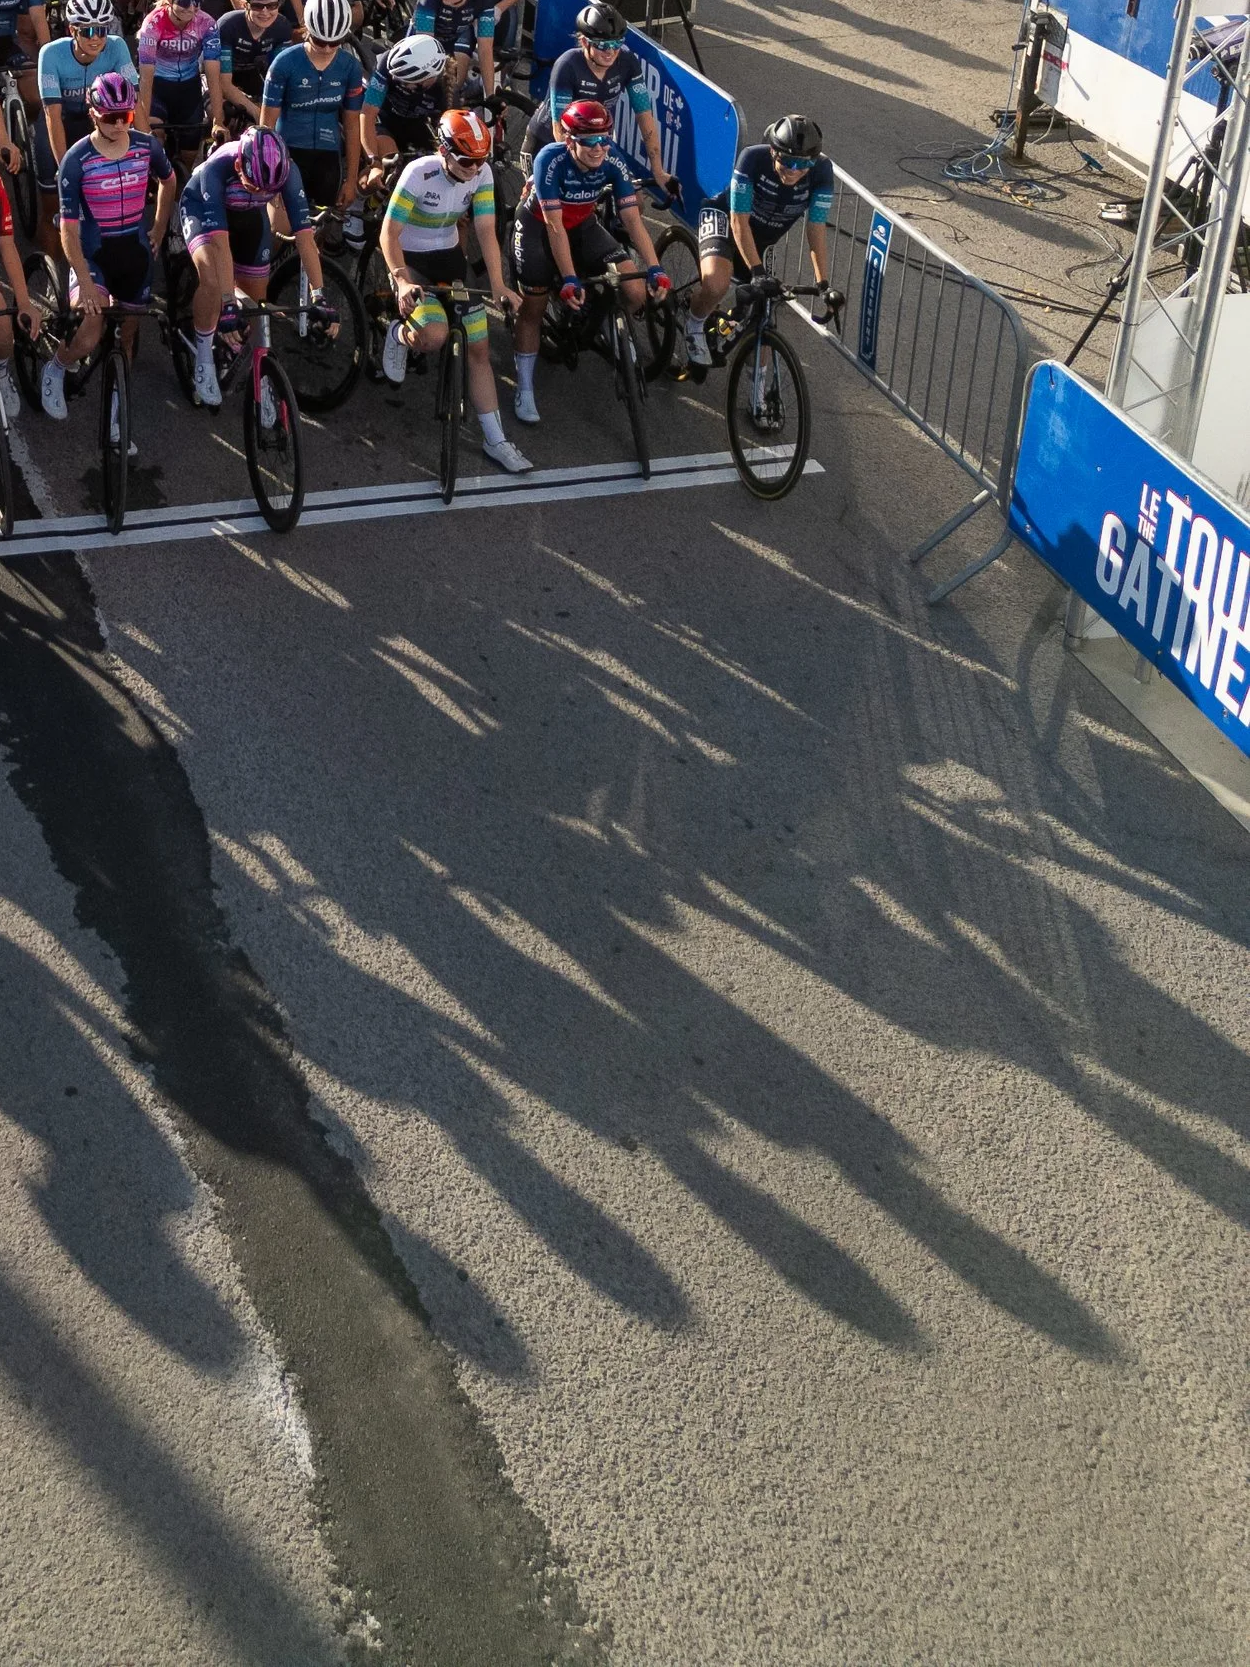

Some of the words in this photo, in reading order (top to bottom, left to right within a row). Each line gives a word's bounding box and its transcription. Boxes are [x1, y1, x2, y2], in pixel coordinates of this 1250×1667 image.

[663, 84, 676, 110] DE
[1139, 482, 1162, 524] LE
[1137, 513, 1158, 546] THE
[1095, 512, 1250, 728] GATINE
